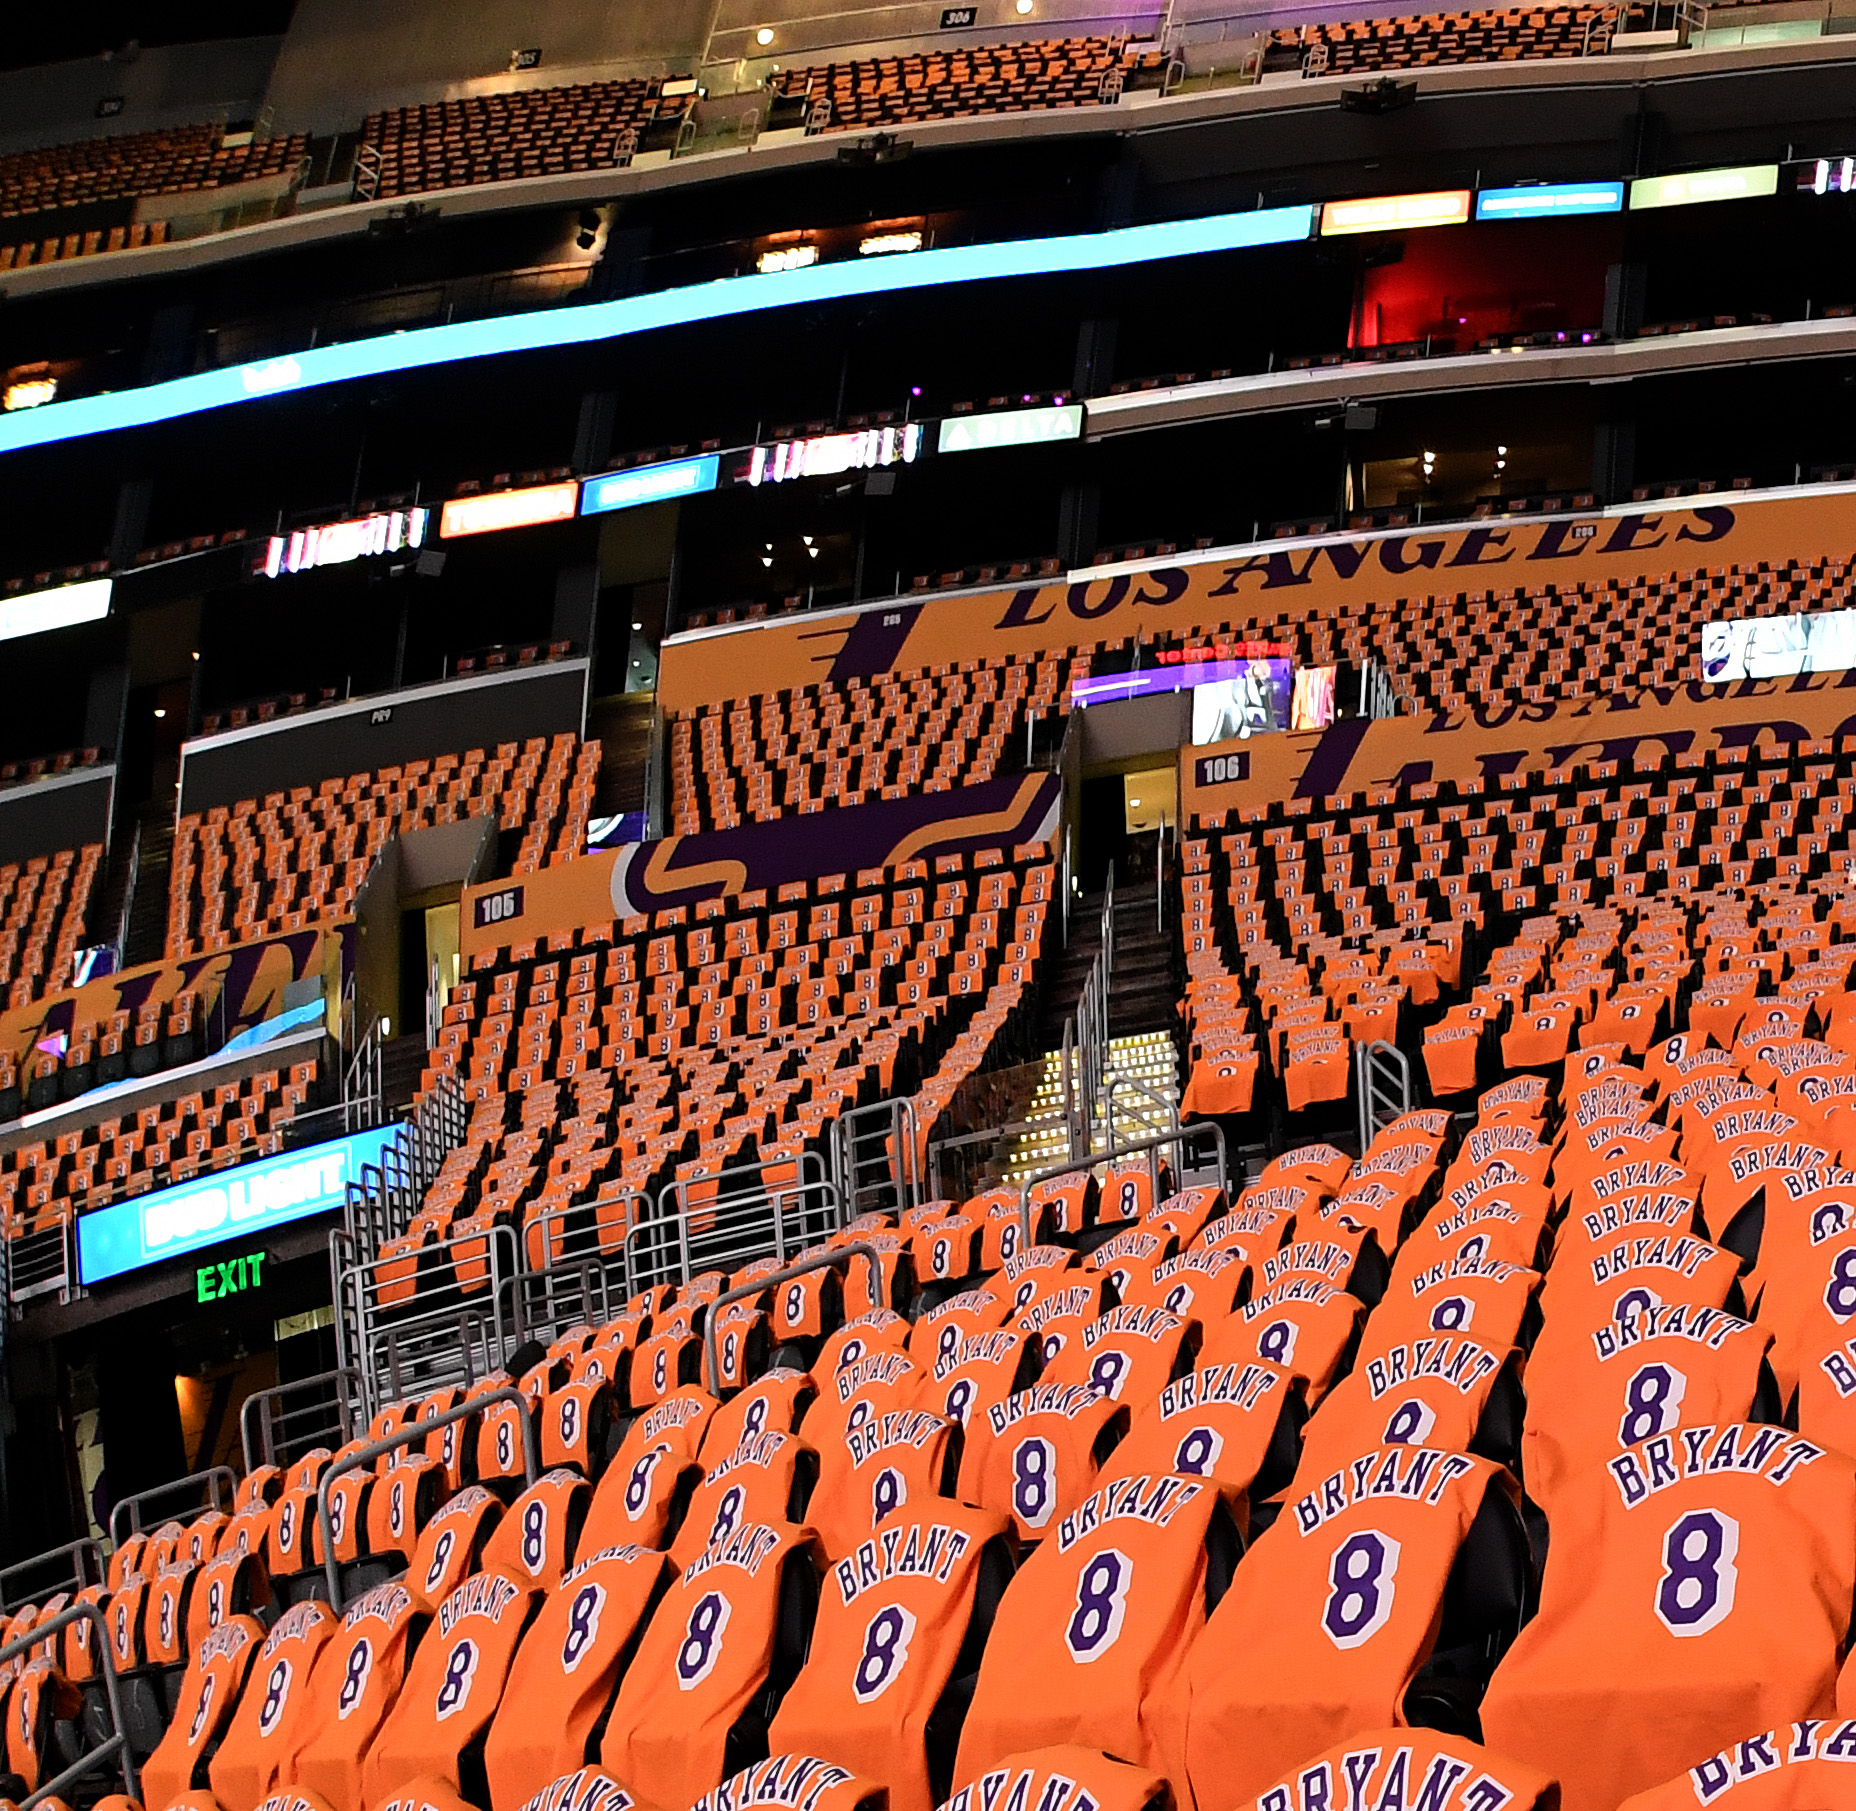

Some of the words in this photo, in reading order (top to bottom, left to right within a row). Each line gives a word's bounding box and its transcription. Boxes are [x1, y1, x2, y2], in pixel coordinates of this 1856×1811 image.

[976, 413, 1071, 440] DELTA
[993, 565, 1191, 631] LOS
[1204, 755, 1240, 783] 106
[483, 893, 515, 922] 105
[1664, 1037, 1687, 1064] 8
[143, 1201, 222, 1246] BUD
[226, 1150, 345, 1222] LIGHT
[1120, 1181, 1137, 1217] 8
[196, 1252, 267, 1303] EXIT
[931, 1238, 950, 1278] 8
[784, 1282, 805, 1327] 8
[1366, 1336, 1500, 1402] BRYANT
[1617, 1362, 1688, 1451] 8
[623, 1452, 660, 1522] 8
[1010, 1436, 1059, 1530] 8
[1293, 1448, 1474, 1538] BRYANT
[1607, 1422, 1826, 1510] BRYANT
[277, 1500, 295, 1553] 8
[520, 1500, 547, 1575] 8
[1056, 1473, 1203, 1555] BRYANT
[836, 1523, 971, 1606] BRYANT
[1320, 1529, 1402, 1650] 8
[1652, 1508, 1740, 1638] 8
[675, 1589, 732, 1692] 8
[1063, 1548, 1134, 1665] 8
[434, 1638, 479, 1721] 8
[852, 1603, 916, 1703] 8
